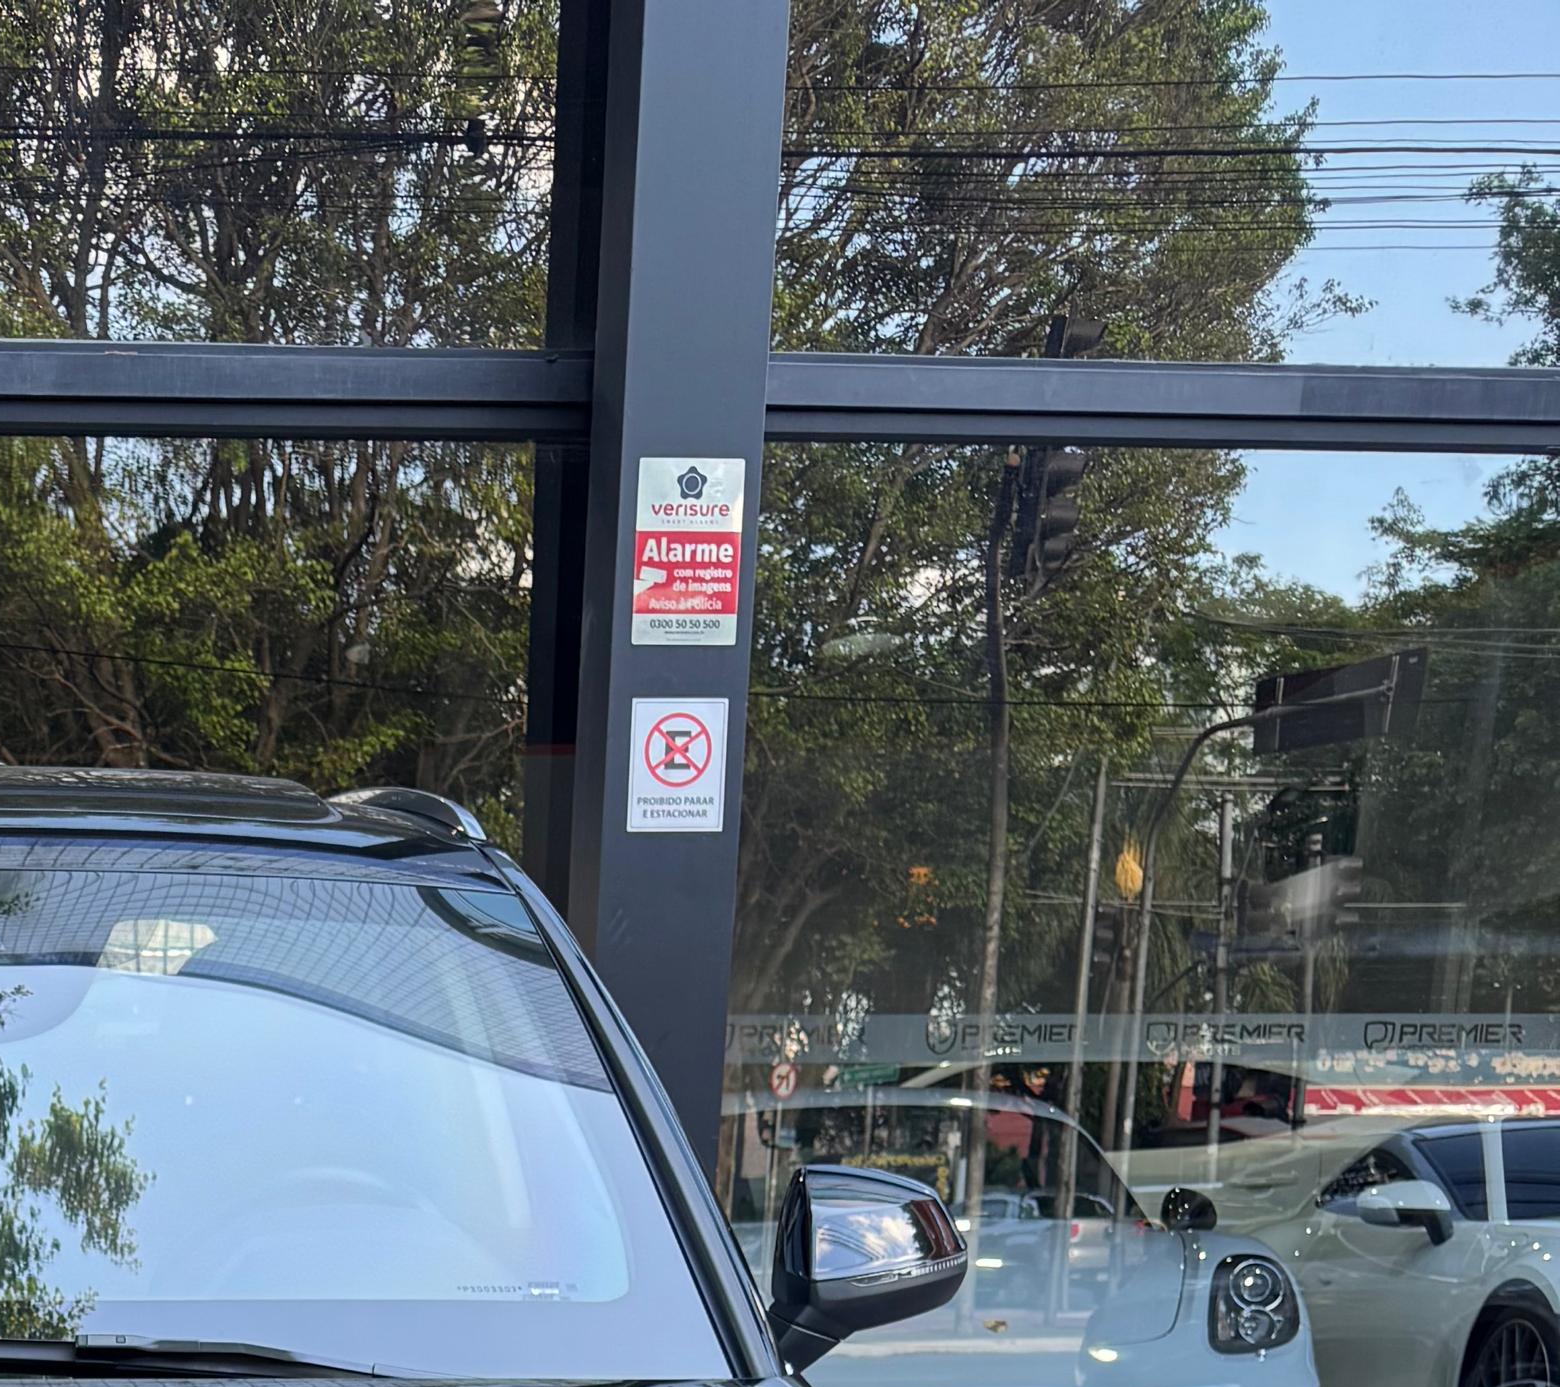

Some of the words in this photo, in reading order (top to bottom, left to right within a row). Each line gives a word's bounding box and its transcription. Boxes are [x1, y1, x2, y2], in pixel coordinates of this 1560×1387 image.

[651, 503, 730, 517] verisure
[642, 536, 734, 563] Alarme
[673, 568, 693, 578] com
[694, 566, 733, 580] registro
[673, 579, 687, 592] de
[688, 579, 732, 595] imagens
[648, 598, 677, 610] Aviso
[649, 619, 674, 629] 0300
[675, 619, 687, 629] 50
[689, 619, 701, 629] 50
[703, 619, 721, 629] 500
[637, 796, 682, 806] PROIBIDO
[683, 796, 715, 806] PARAR
[642, 809, 649, 818] E
[650, 809, 708, 818] ESTACIONAR
[1398, 1023, 1523, 1044] PREMIER
